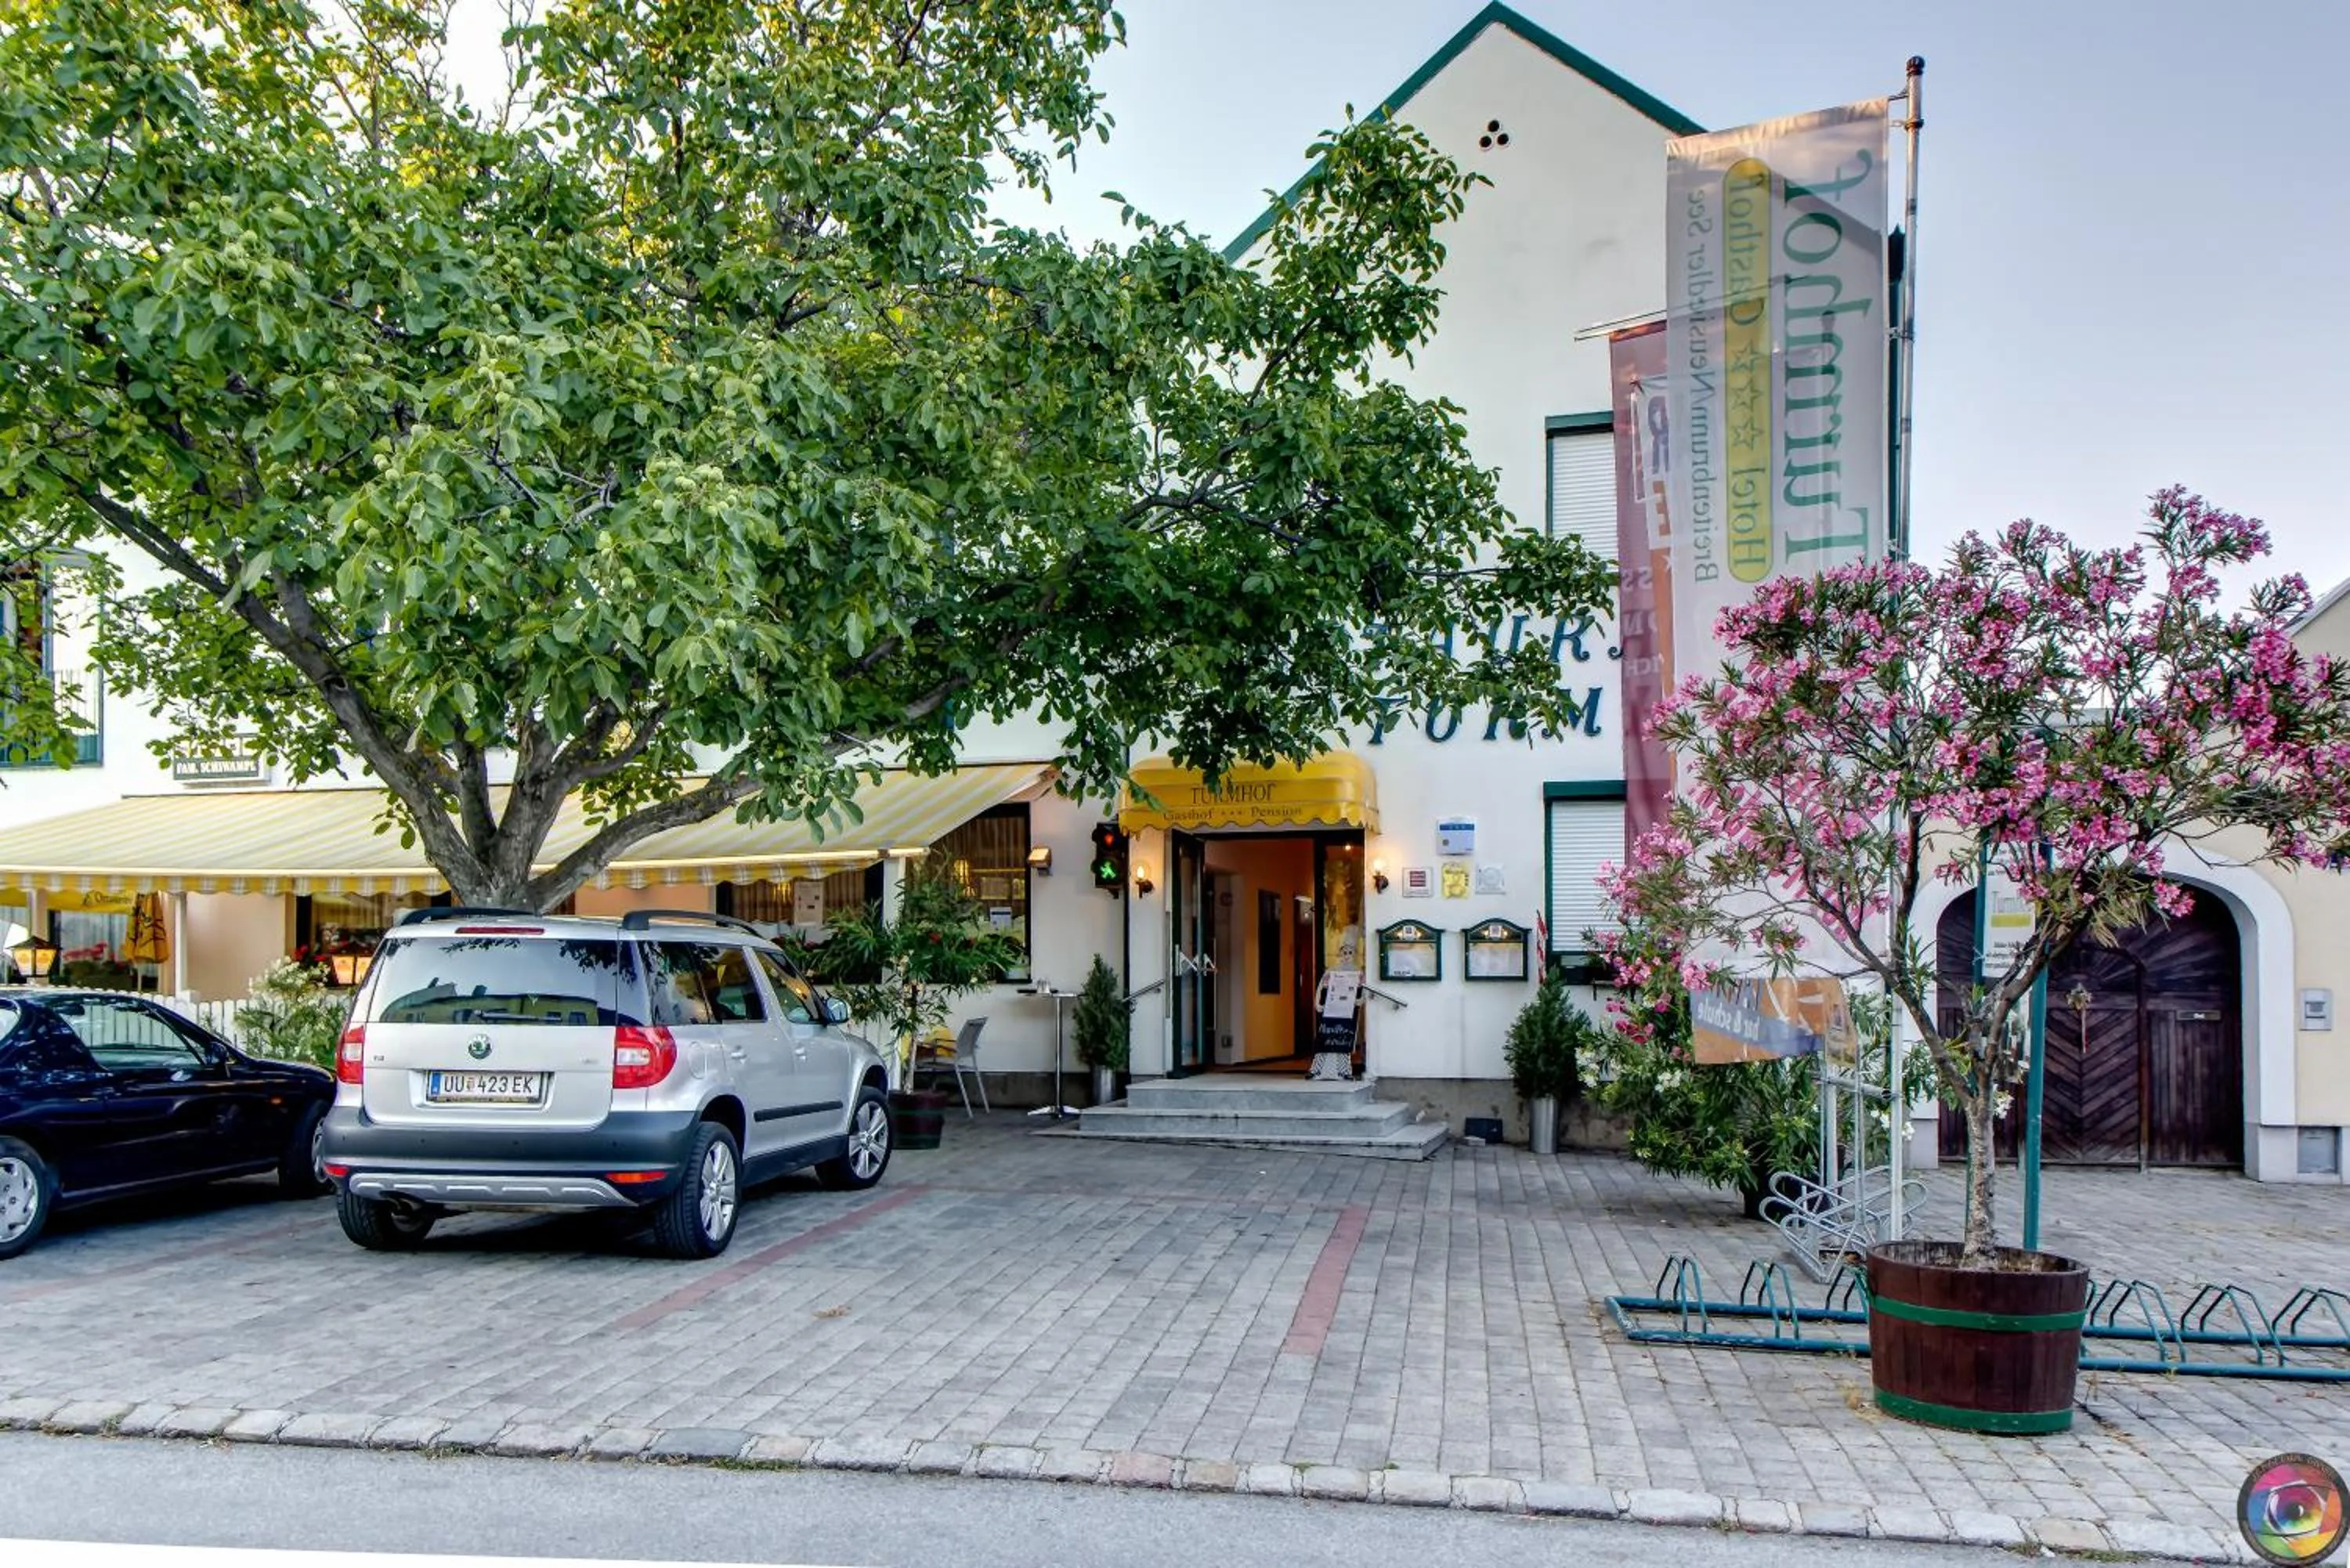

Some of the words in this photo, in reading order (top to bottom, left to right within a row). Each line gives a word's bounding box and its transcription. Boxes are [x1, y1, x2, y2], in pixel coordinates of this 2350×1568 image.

[1163, 807, 1213, 821] Gasthof
[1250, 807, 1301, 818] Pension
[444, 1076, 465, 1093] UU
[478, 1076, 508, 1093] 423
[512, 1077, 533, 1094] EK
